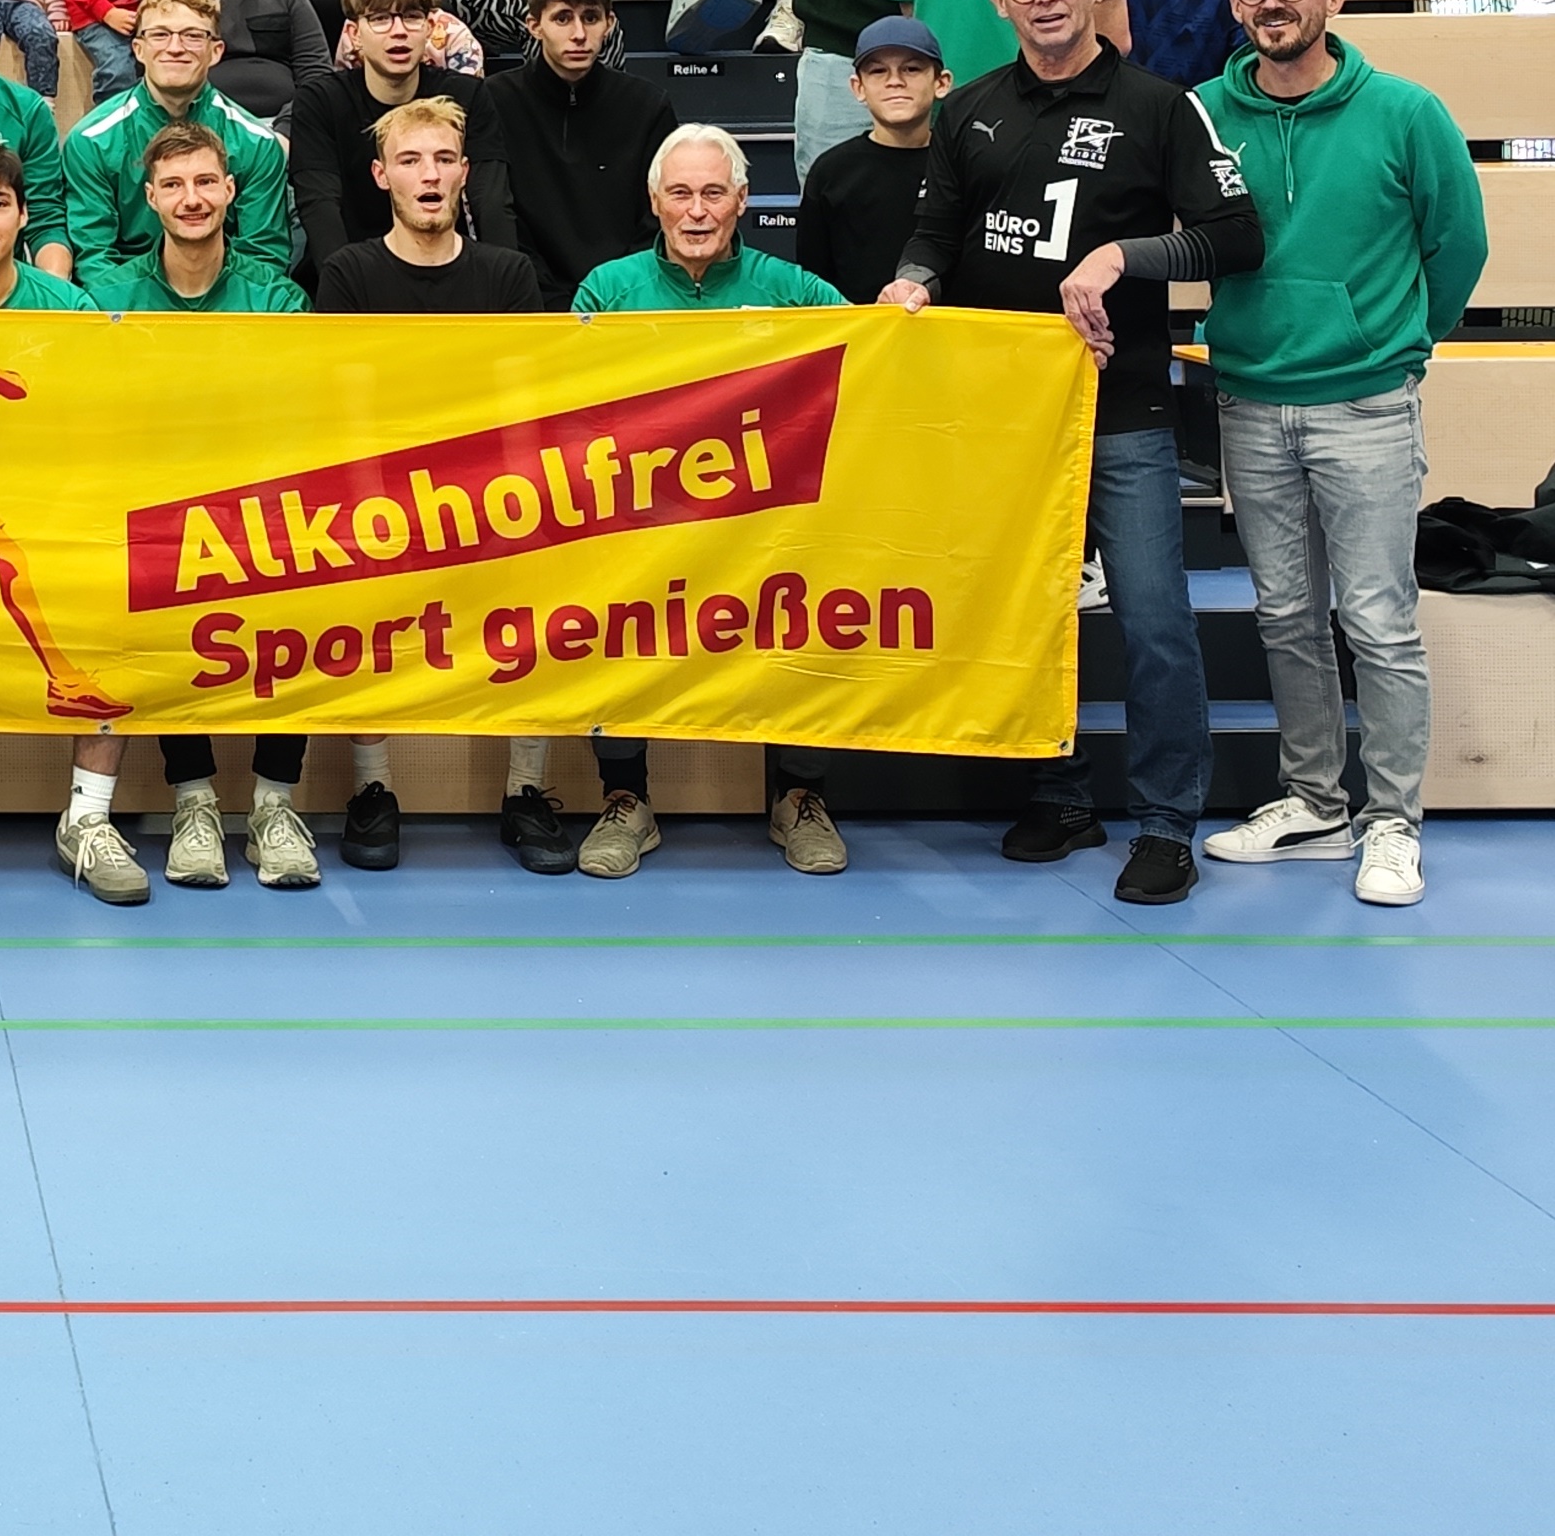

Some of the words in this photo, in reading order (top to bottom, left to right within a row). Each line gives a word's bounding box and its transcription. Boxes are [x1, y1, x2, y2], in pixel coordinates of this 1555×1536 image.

[673, 64, 708, 75] Reihe
[710, 64, 719, 74] 4
[759, 214, 796, 226] Reihe
[985, 209, 1041, 237] BÜRO
[1033, 178, 1078, 261] 1
[984, 232, 1024, 255] EINS
[174, 407, 773, 594] Alkoholfrei
[189, 600, 454, 699] Sport
[482, 571, 935, 684] genießen
